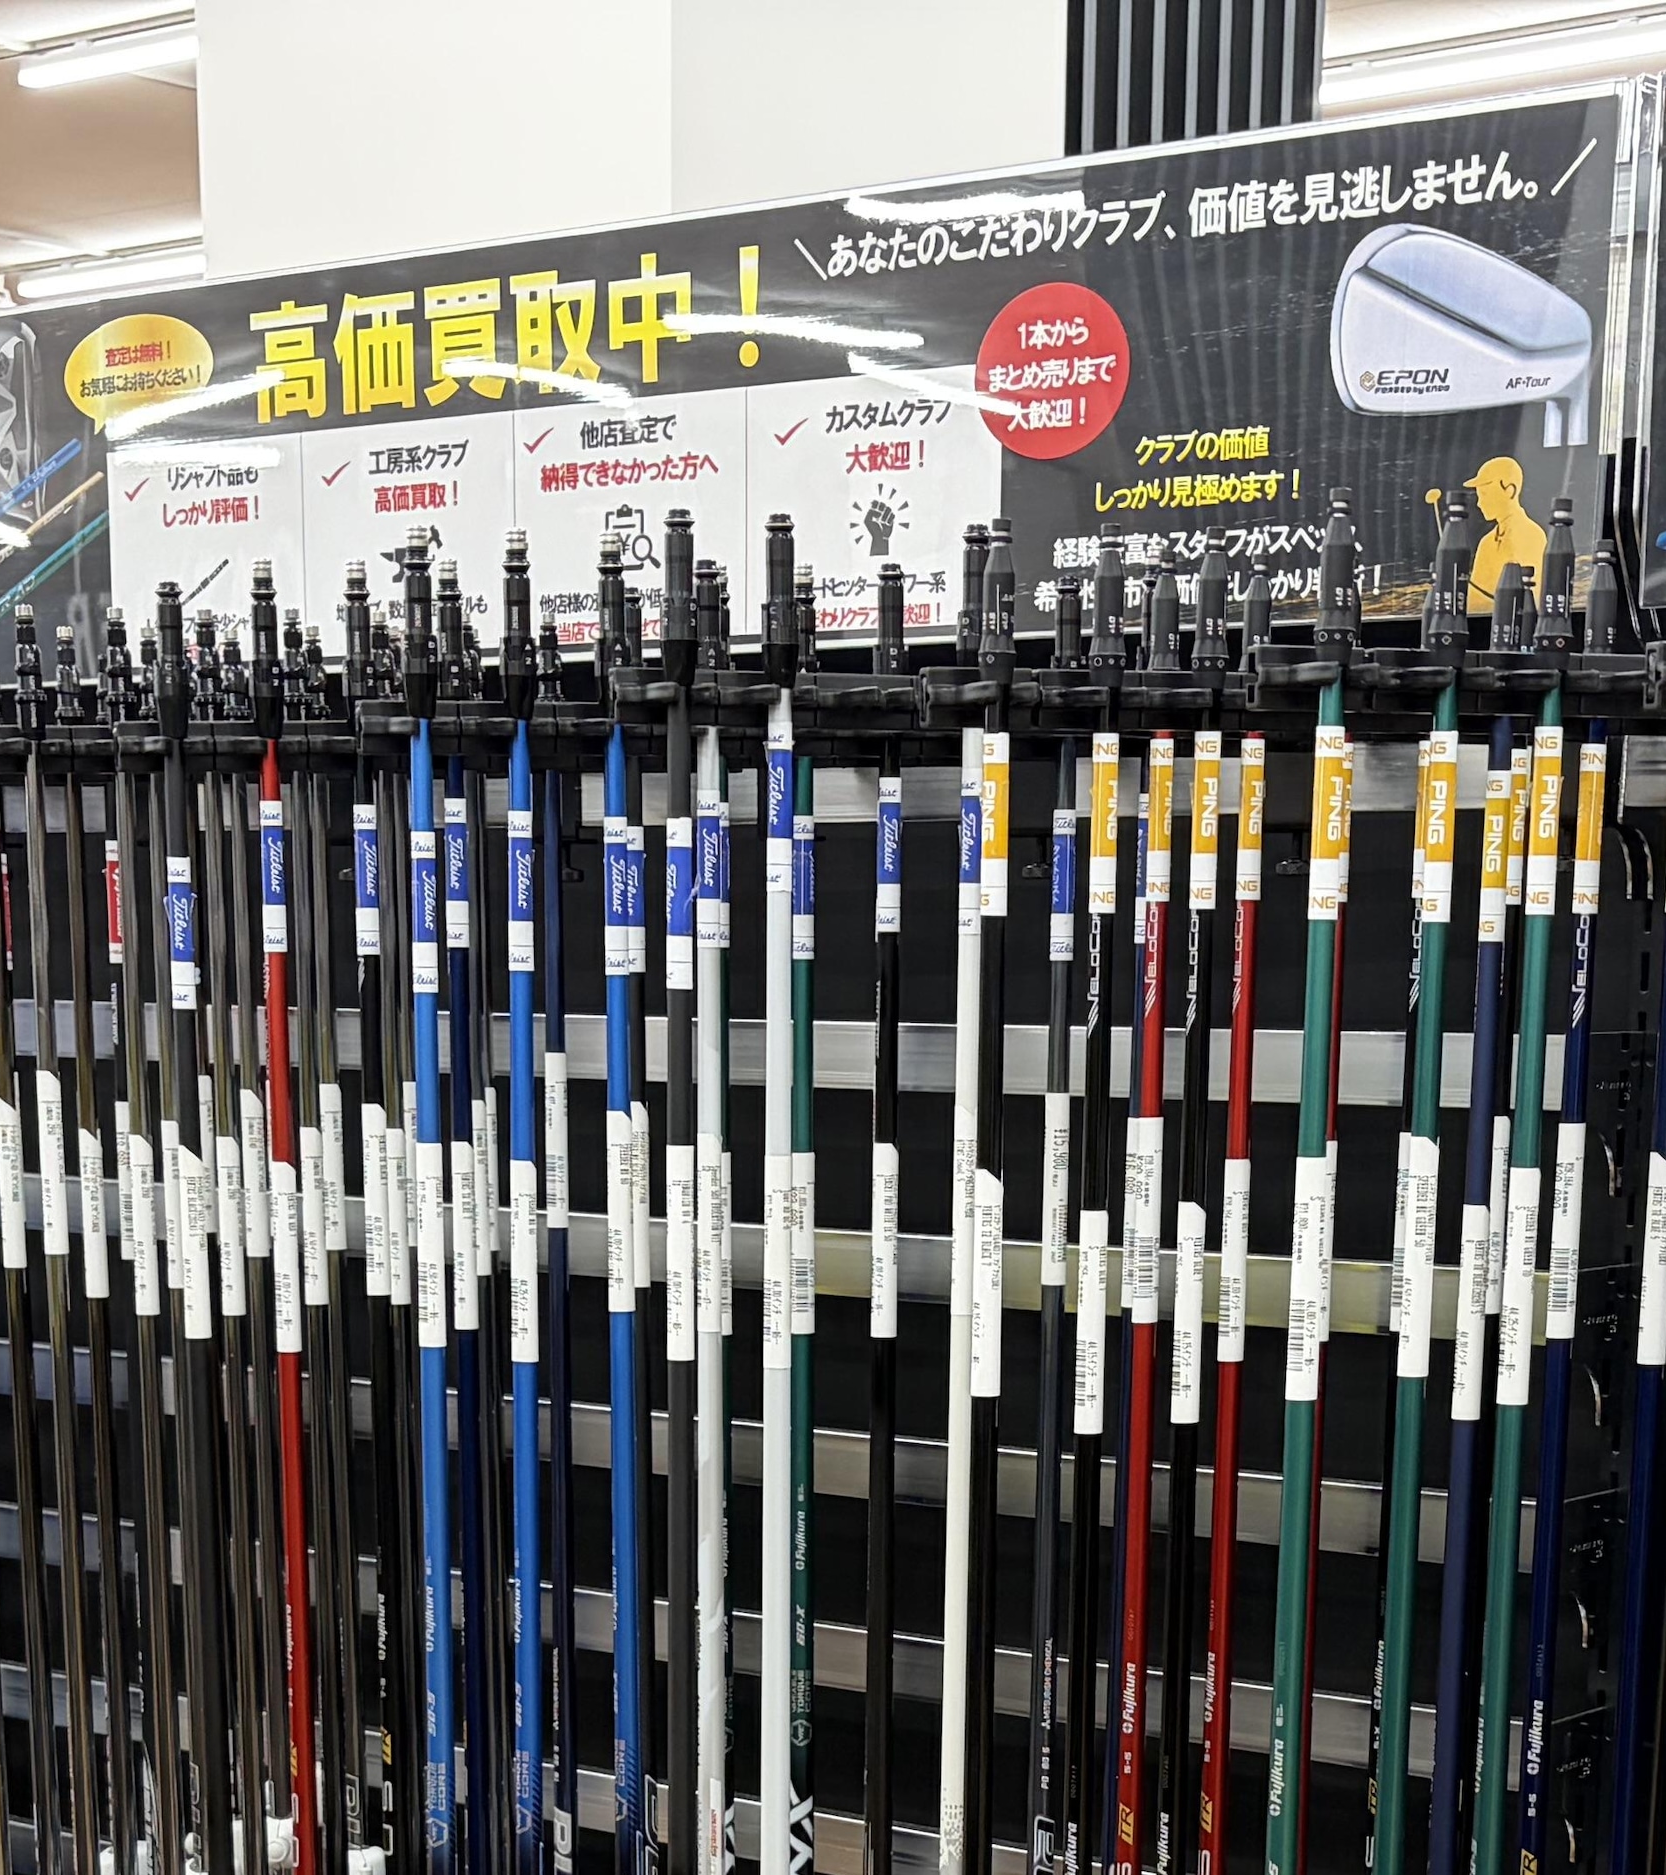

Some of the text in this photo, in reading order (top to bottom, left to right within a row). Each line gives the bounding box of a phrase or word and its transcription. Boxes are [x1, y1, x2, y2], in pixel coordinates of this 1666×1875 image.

[826, 150, 1539, 280] あなたのこだわりクラブ、価値を見逃しません。
[249, 245, 761, 425] 高価買取中！
[1017, 316, 1091, 353] 1本から
[987, 353, 1119, 391] まとめ売りまで
[1377, 368, 1450, 386] EPON
[580, 414, 676, 450] 他店査定で
[1006, 399, 1087, 432] 大歓迎！
[368, 440, 469, 474] 工房系クラブ
[540, 451, 719, 493] 納得できなかった方へ
[845, 441, 924, 474] 大歓迎！
[1134, 425, 1270, 464] クラブの価値
[162, 495, 259, 527] しっかり評価！
[374, 481, 459, 514] 高価買取！
[1095, 467, 1301, 512] しっかり見極めます！
[768, 766, 785, 826] Titleist
[1201, 777, 1219, 838] PING
[1248, 779, 1263, 836] PING
[1327, 776, 1344, 842] PING
[1428, 779, 1448, 845] PING
[1512, 787, 1528, 843] PING
[1538, 774, 1558, 839] PING
[267, 837, 281, 894] Titleist
[364, 840, 377, 897] Titleist
[448, 834, 461, 890] Titleist
[701, 826, 718, 888] Titleist
[883, 817, 900, 873] Titleist
[1485, 814, 1504, 874] PING
[421, 869, 436, 931] Titleist
[515, 849, 531, 910] Titleist
[610, 854, 626, 914] Titleist
[173, 895, 188, 952] Titleist
[1123, 1661, 1137, 1720] Fujikura
[1204, 1652, 1216, 1708] Fujikura
[1527, 1699, 1544, 1761] Fujikura
[1269, 1739, 1285, 1801] Fujikura
[1157, 1812, 1169, 1875] Fujikura
